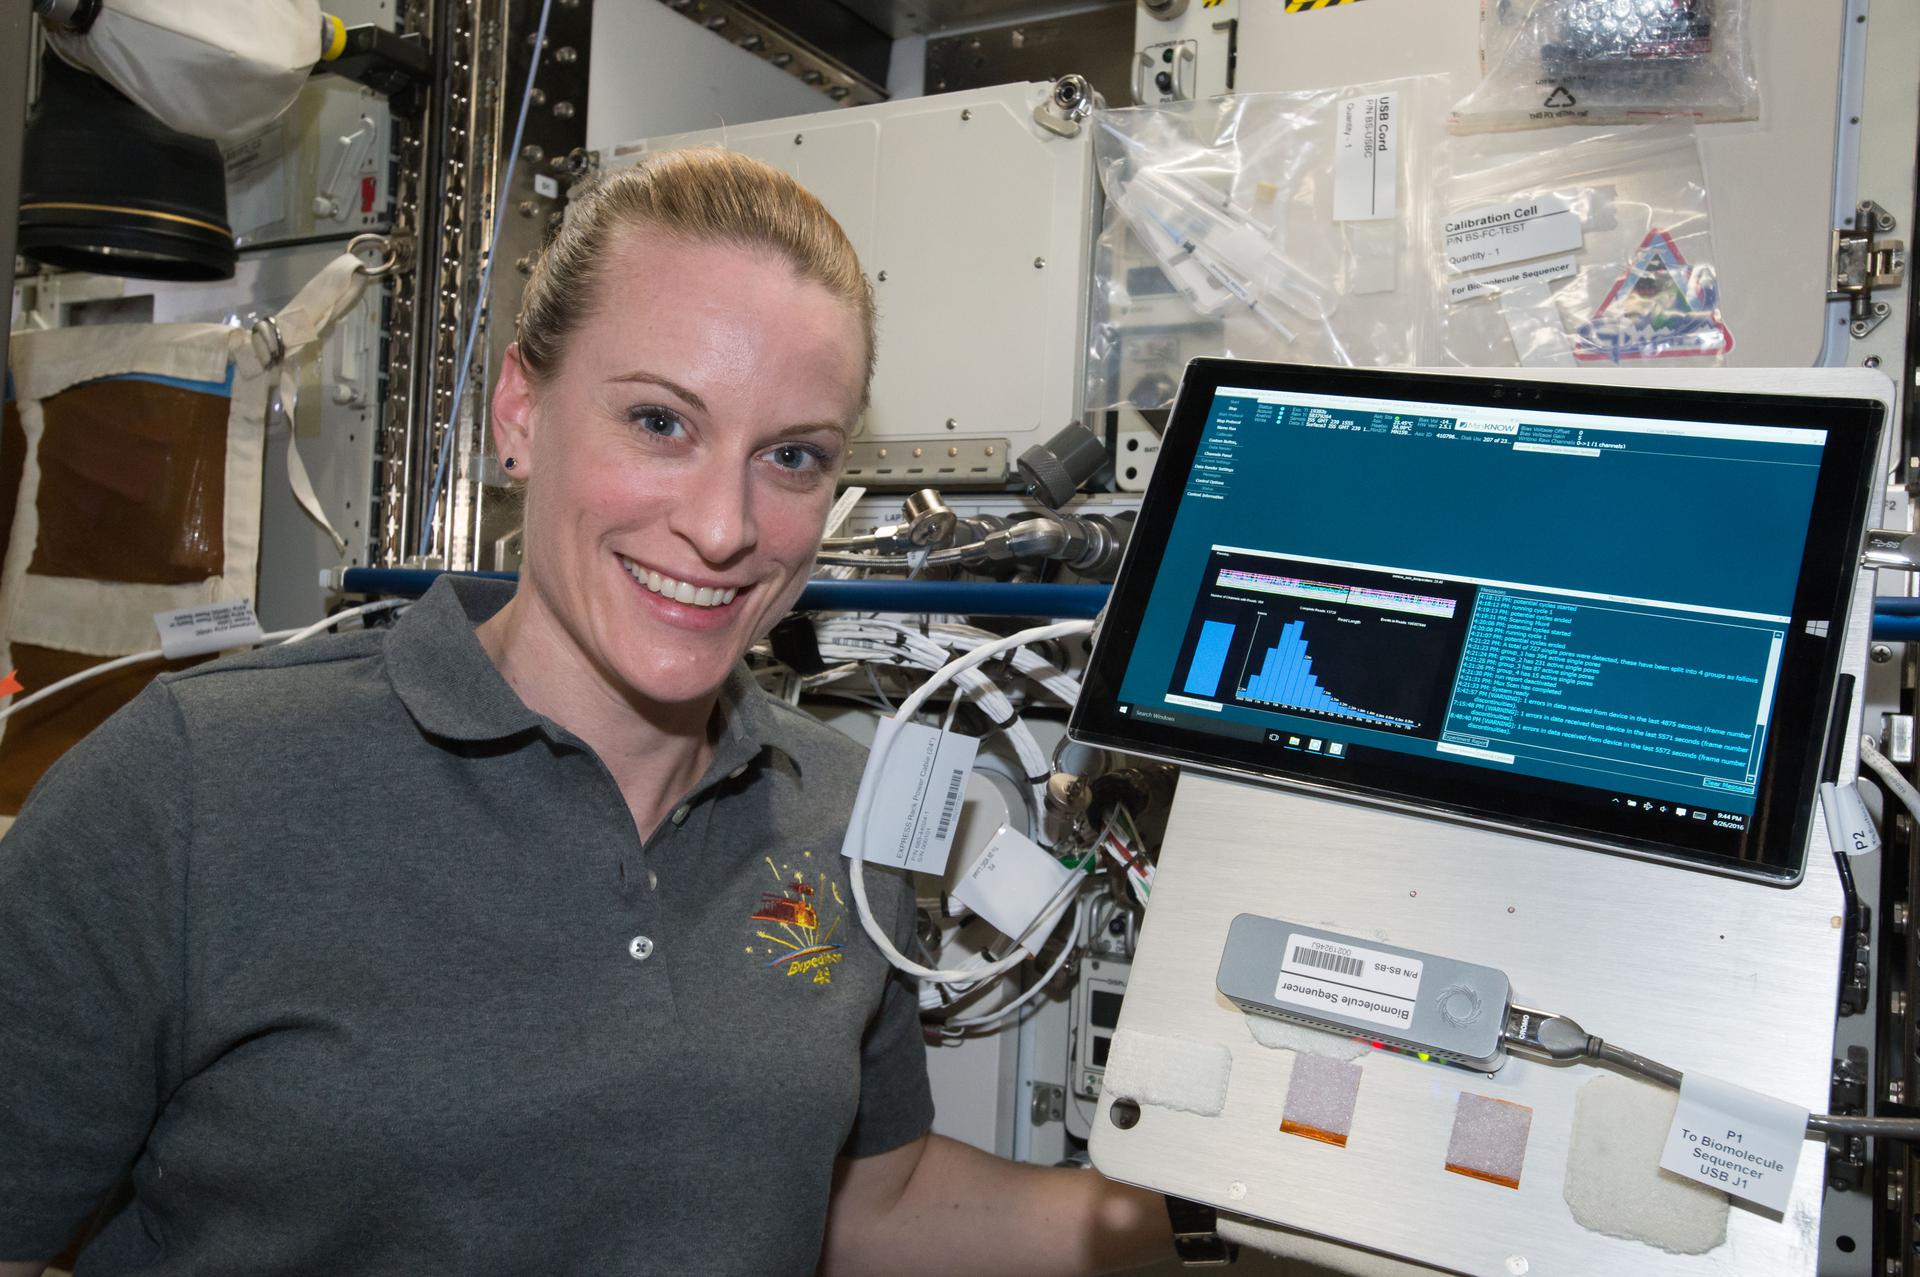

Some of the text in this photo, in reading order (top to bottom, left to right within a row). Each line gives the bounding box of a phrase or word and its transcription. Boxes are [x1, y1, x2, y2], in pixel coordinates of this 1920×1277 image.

[1344, 103, 1354, 136] Quantity
[1378, 96, 1390, 151] USB Cord
[1364, 116, 1374, 158] BS-USBC
[1445, 205, 1538, 233] Calibration Cell
[1446, 223, 1526, 246] P/N BS-FC-TEST
[1450, 251, 1485, 265] Quantity
[1451, 286, 1464, 296] For
[1522, 263, 1569, 279] Sequencer
[1491, 686, 1512, 695] System
[1531, 686, 1562, 696] completed
[1135, 709, 1175, 722] Search Windows
[1567, 705, 1592, 713] received
[1676, 722, 1702, 731] seconds
[1703, 726, 1726, 735] (frame
[1726, 730, 1751, 738] number
[896, 821, 912, 859] EXPRESS
[908, 803, 917, 819] Rack
[913, 778, 924, 801] Power
[920, 756, 930, 776] Cable
[1712, 819, 1744, 830] 8/26/2016
[1853, 830, 1868, 850] P2
[1374, 963, 1418, 979] P/N BS-BS
[1282, 982, 1409, 1020] Biomolecule Sequencer
[1726, 1130, 1743, 1143] P1
[1681, 1128, 1784, 1172] To Biomolecule
[1693, 1147, 1764, 1180] Sequencer
[1700, 1165, 1748, 1189] USB J1
